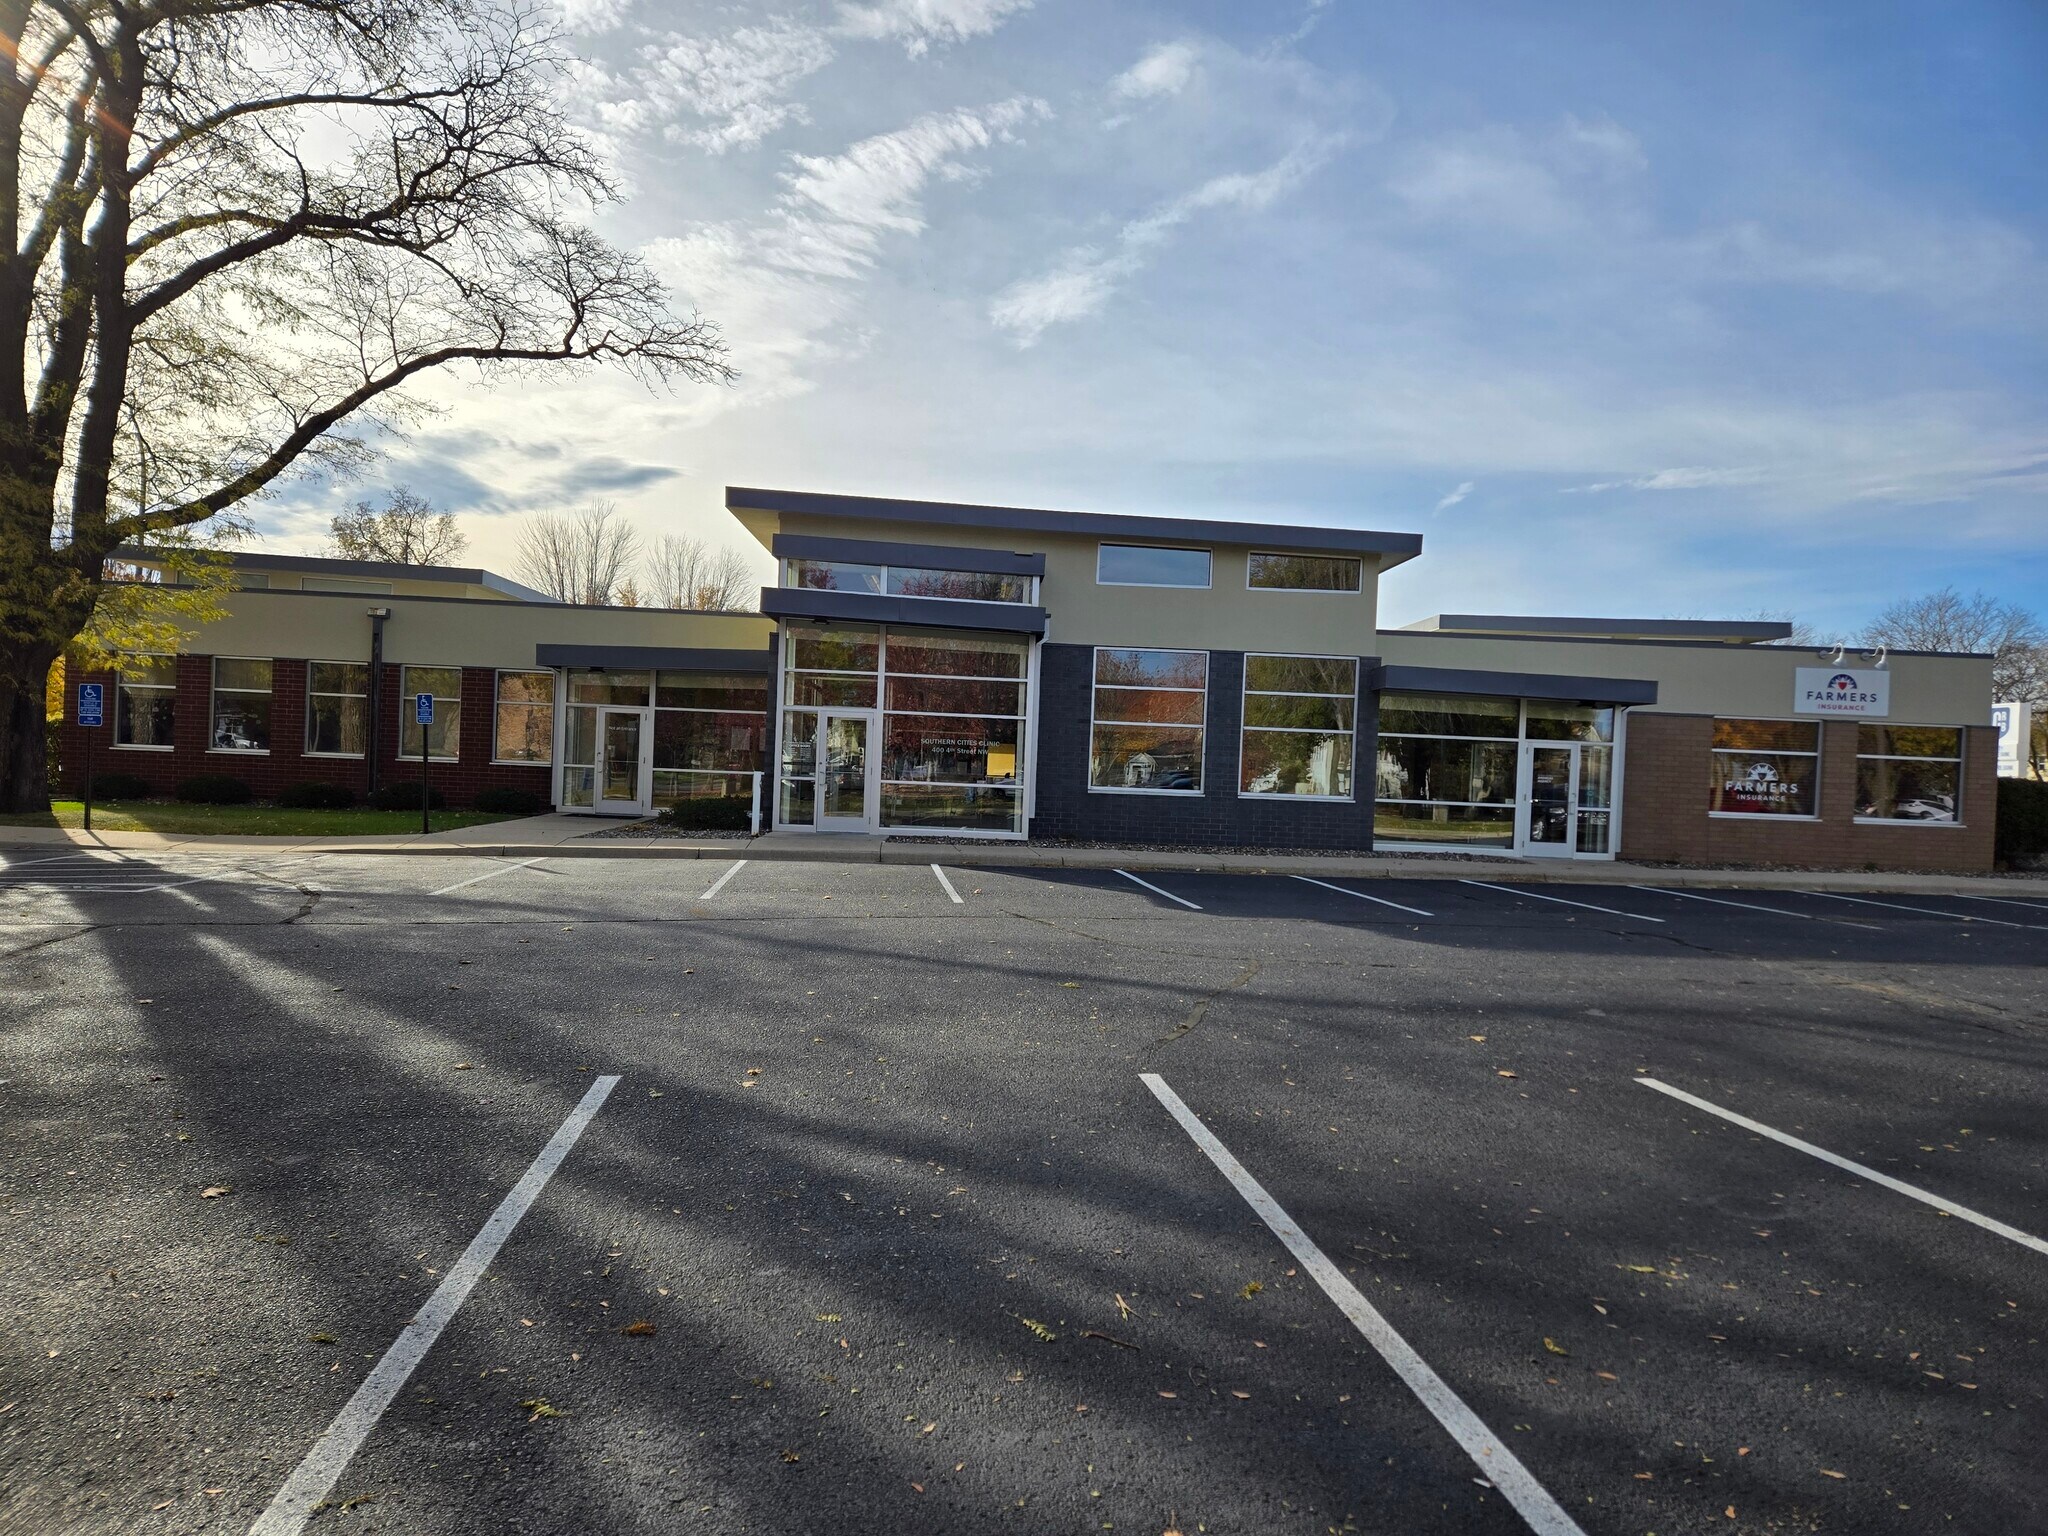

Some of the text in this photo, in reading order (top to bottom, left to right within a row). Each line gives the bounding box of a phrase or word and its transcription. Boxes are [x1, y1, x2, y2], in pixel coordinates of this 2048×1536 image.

[1807, 691, 1877, 703] FARMERS
[957, 747, 976, 755] Street
[1725, 781, 1798, 793] FARMERS
